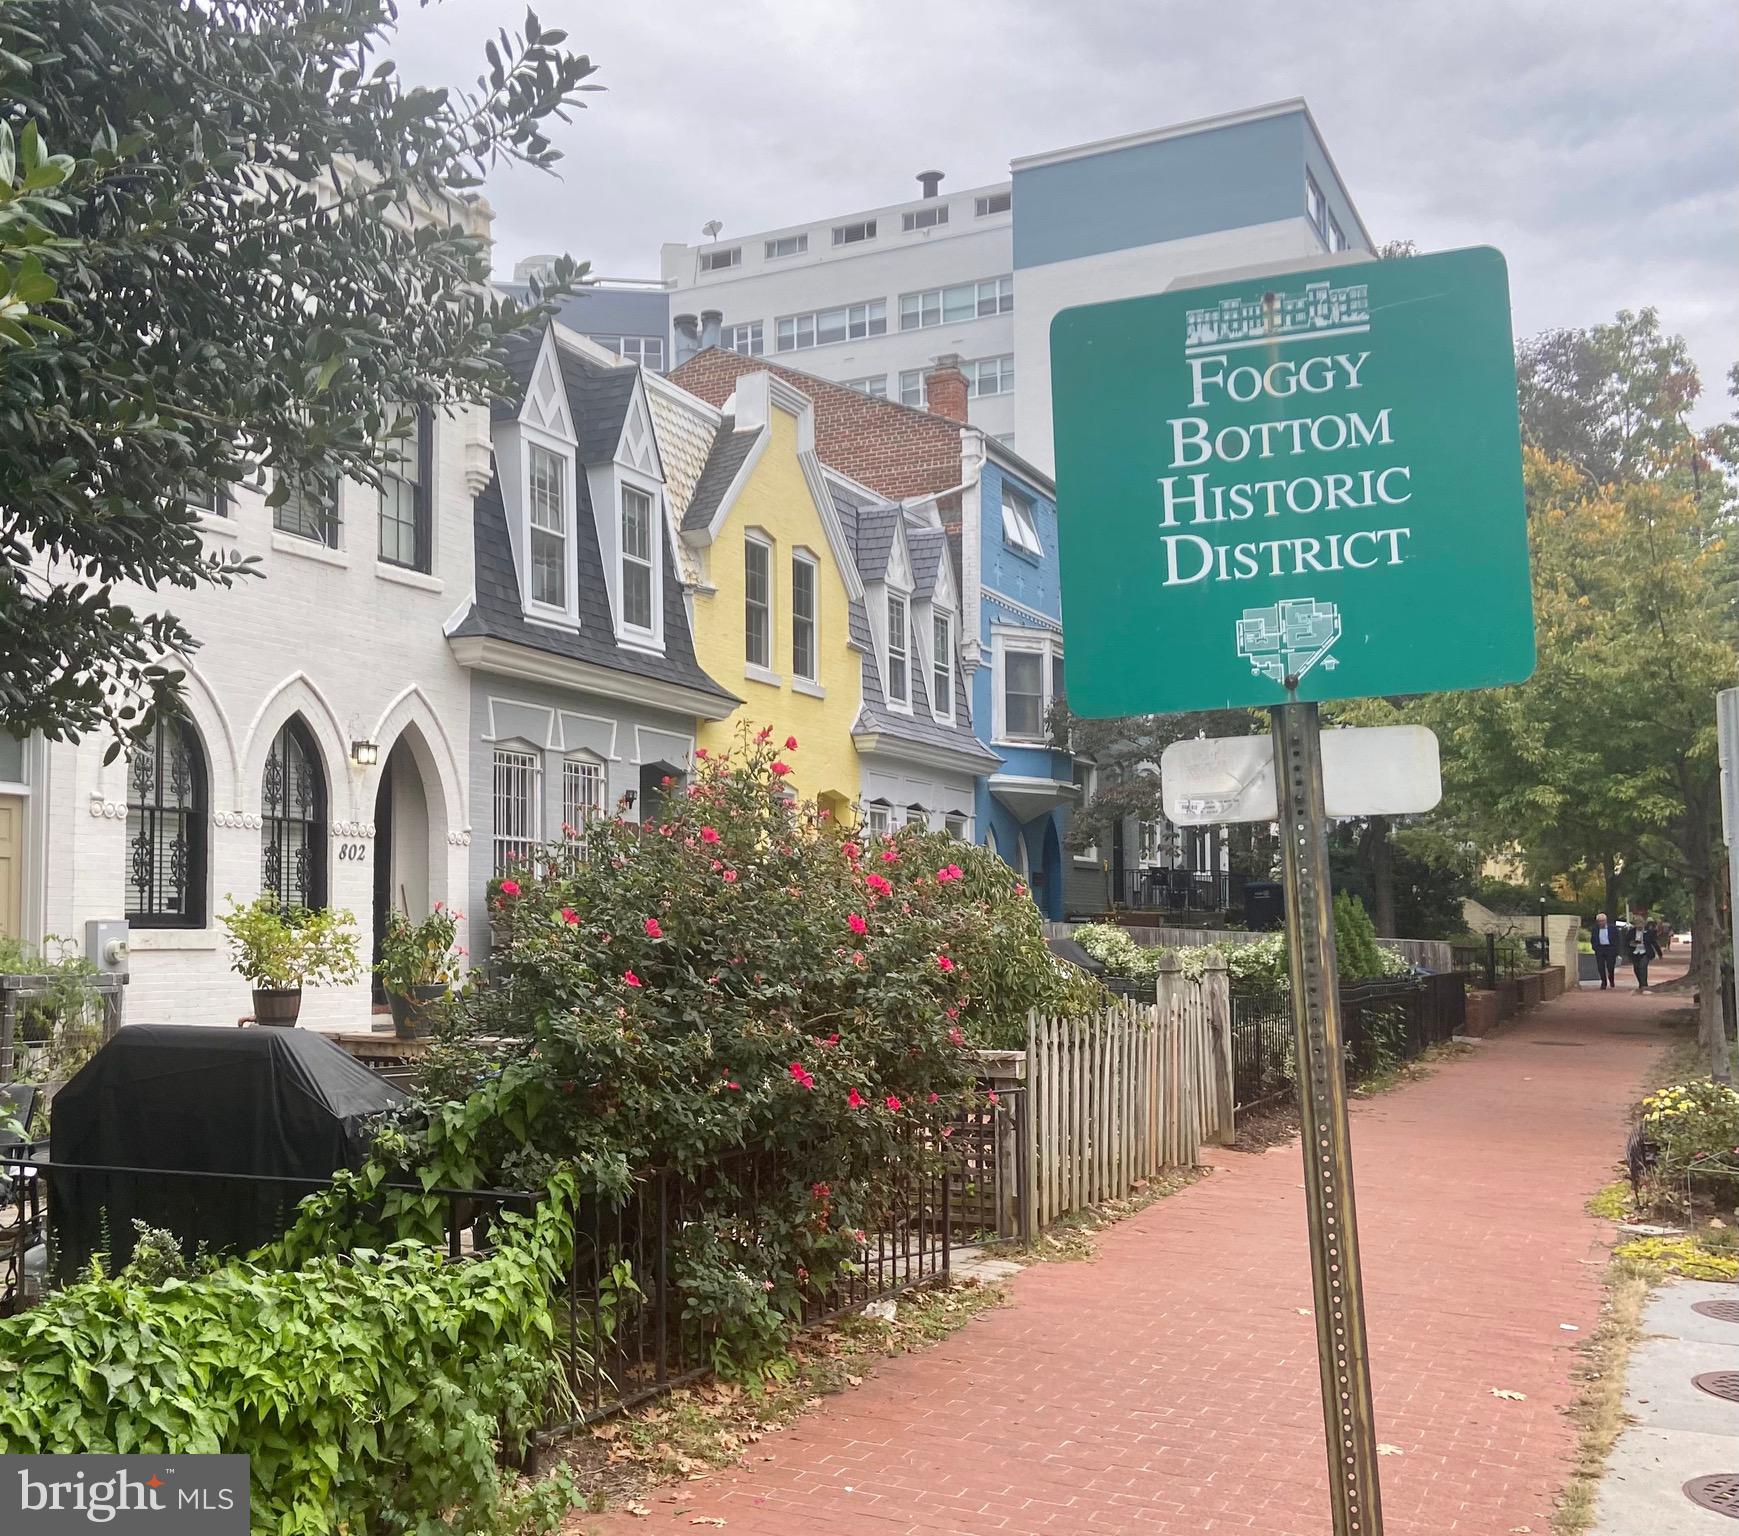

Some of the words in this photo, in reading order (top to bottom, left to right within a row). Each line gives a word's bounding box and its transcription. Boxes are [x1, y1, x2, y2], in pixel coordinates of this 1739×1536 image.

[1187, 352, 1370, 408] FOGGY
[1167, 409, 1394, 468] BOTTOM
[1158, 466, 1412, 527] HISTORIC
[1160, 528, 1410, 587] DISTRICT
[338, 843, 366, 861] 802
